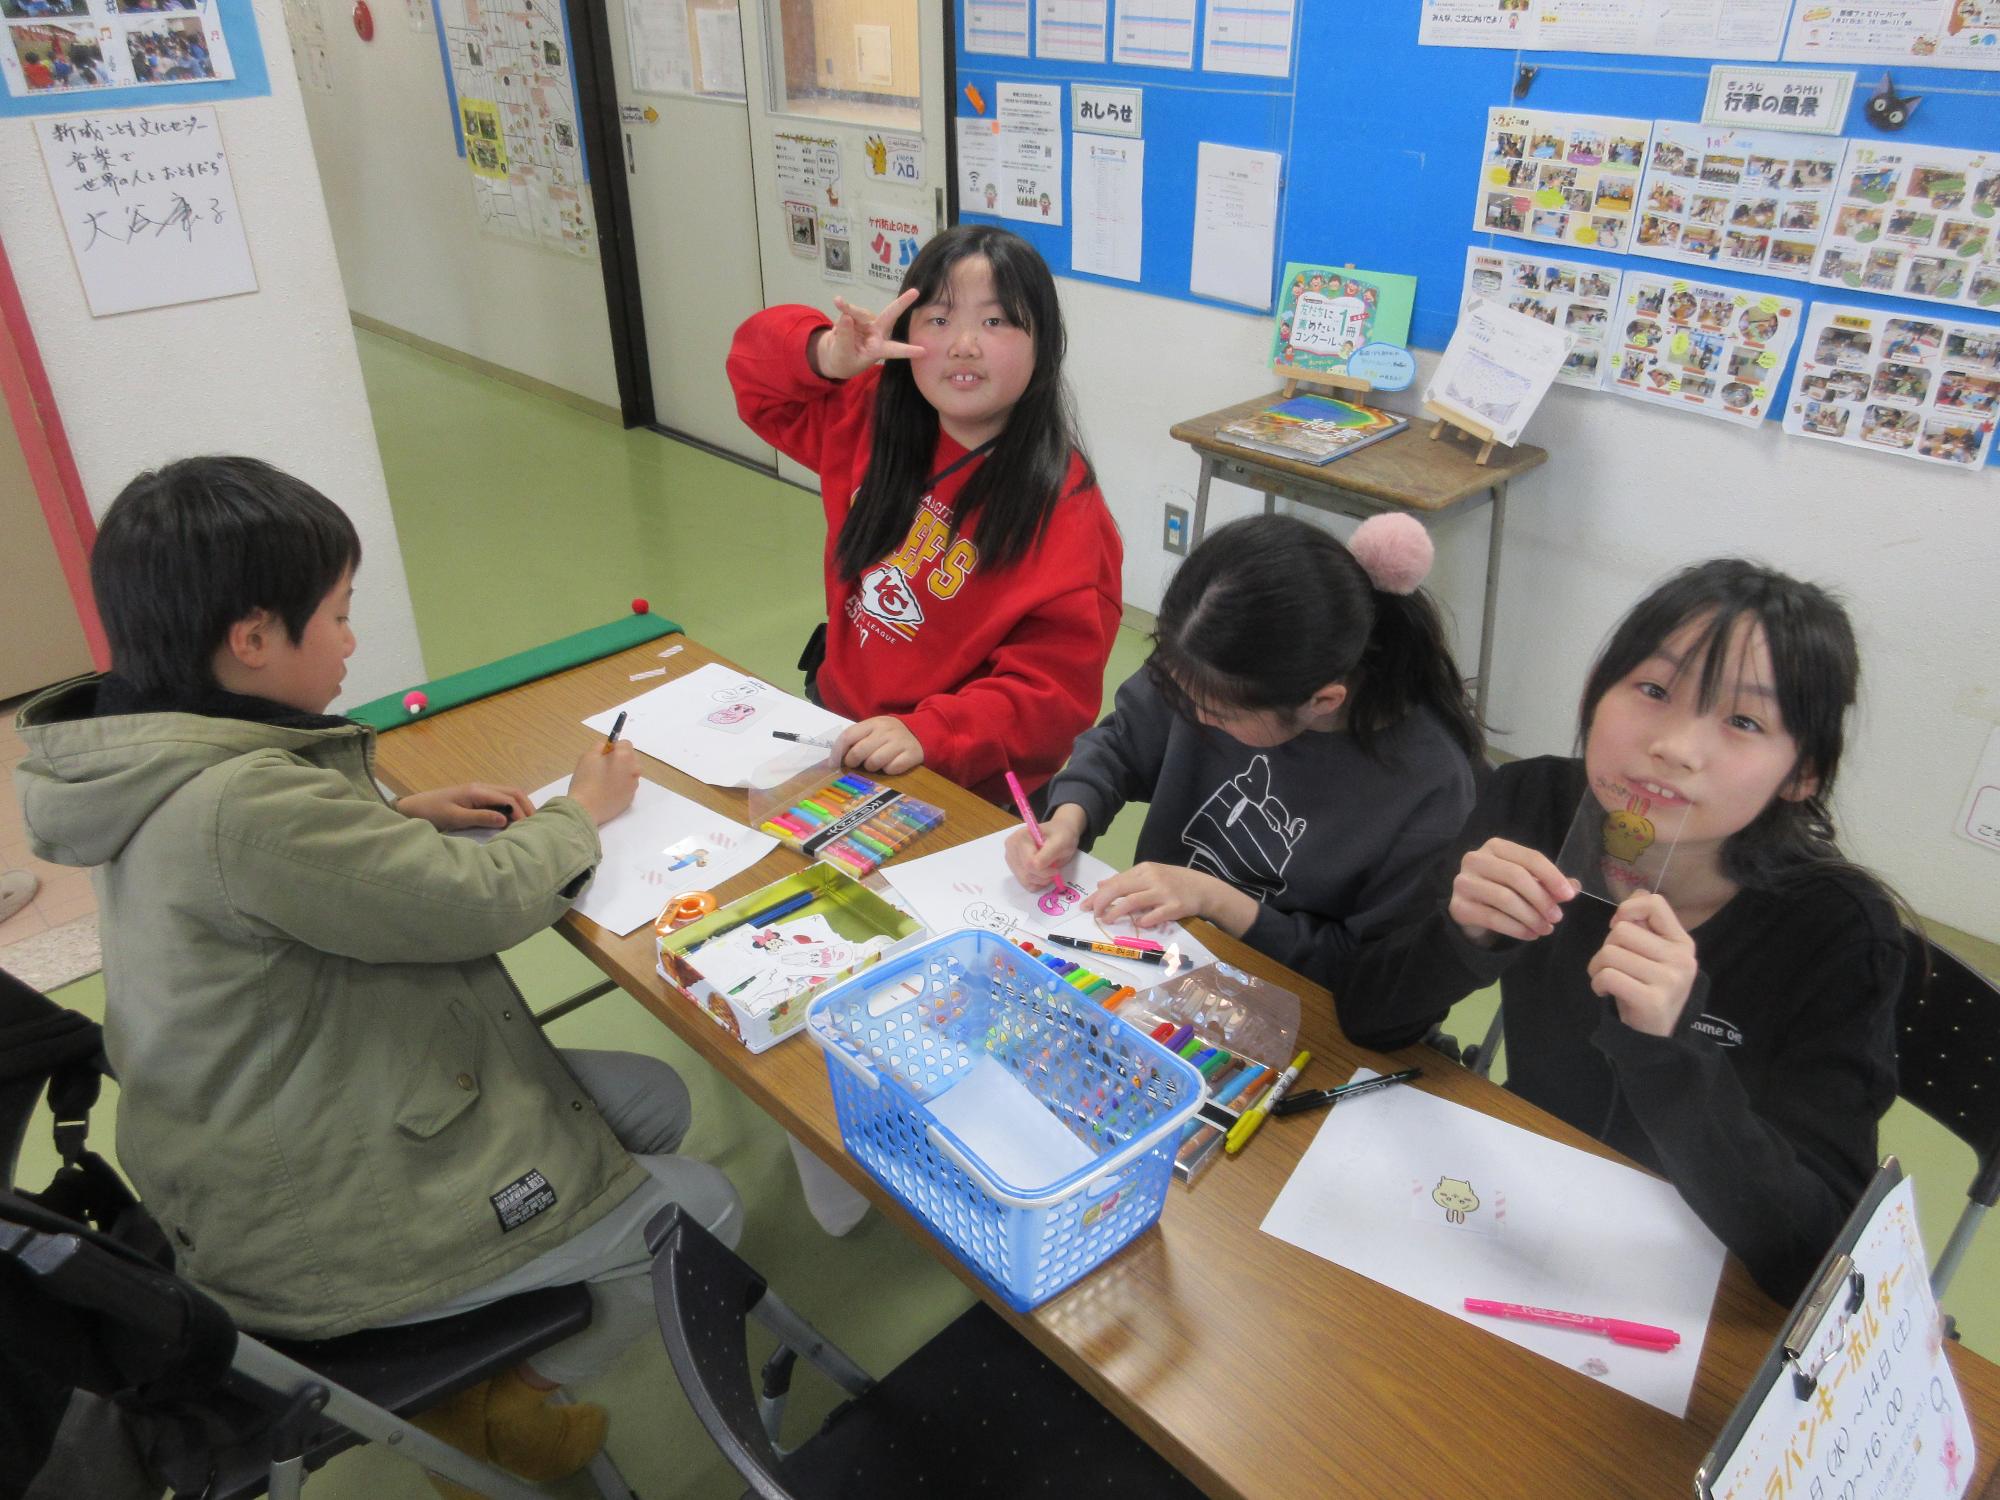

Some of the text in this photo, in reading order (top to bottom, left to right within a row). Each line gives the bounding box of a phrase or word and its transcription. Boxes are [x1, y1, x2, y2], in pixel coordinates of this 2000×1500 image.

[1080, 101, 1133, 123] おしらせ
[1724, 92, 1820, 117] 行事の風景
[868, 216, 920, 235] ケガ防止のため
[1295, 332, 1337, 347] コンクール
[866, 619, 898, 645] LEAGUE
